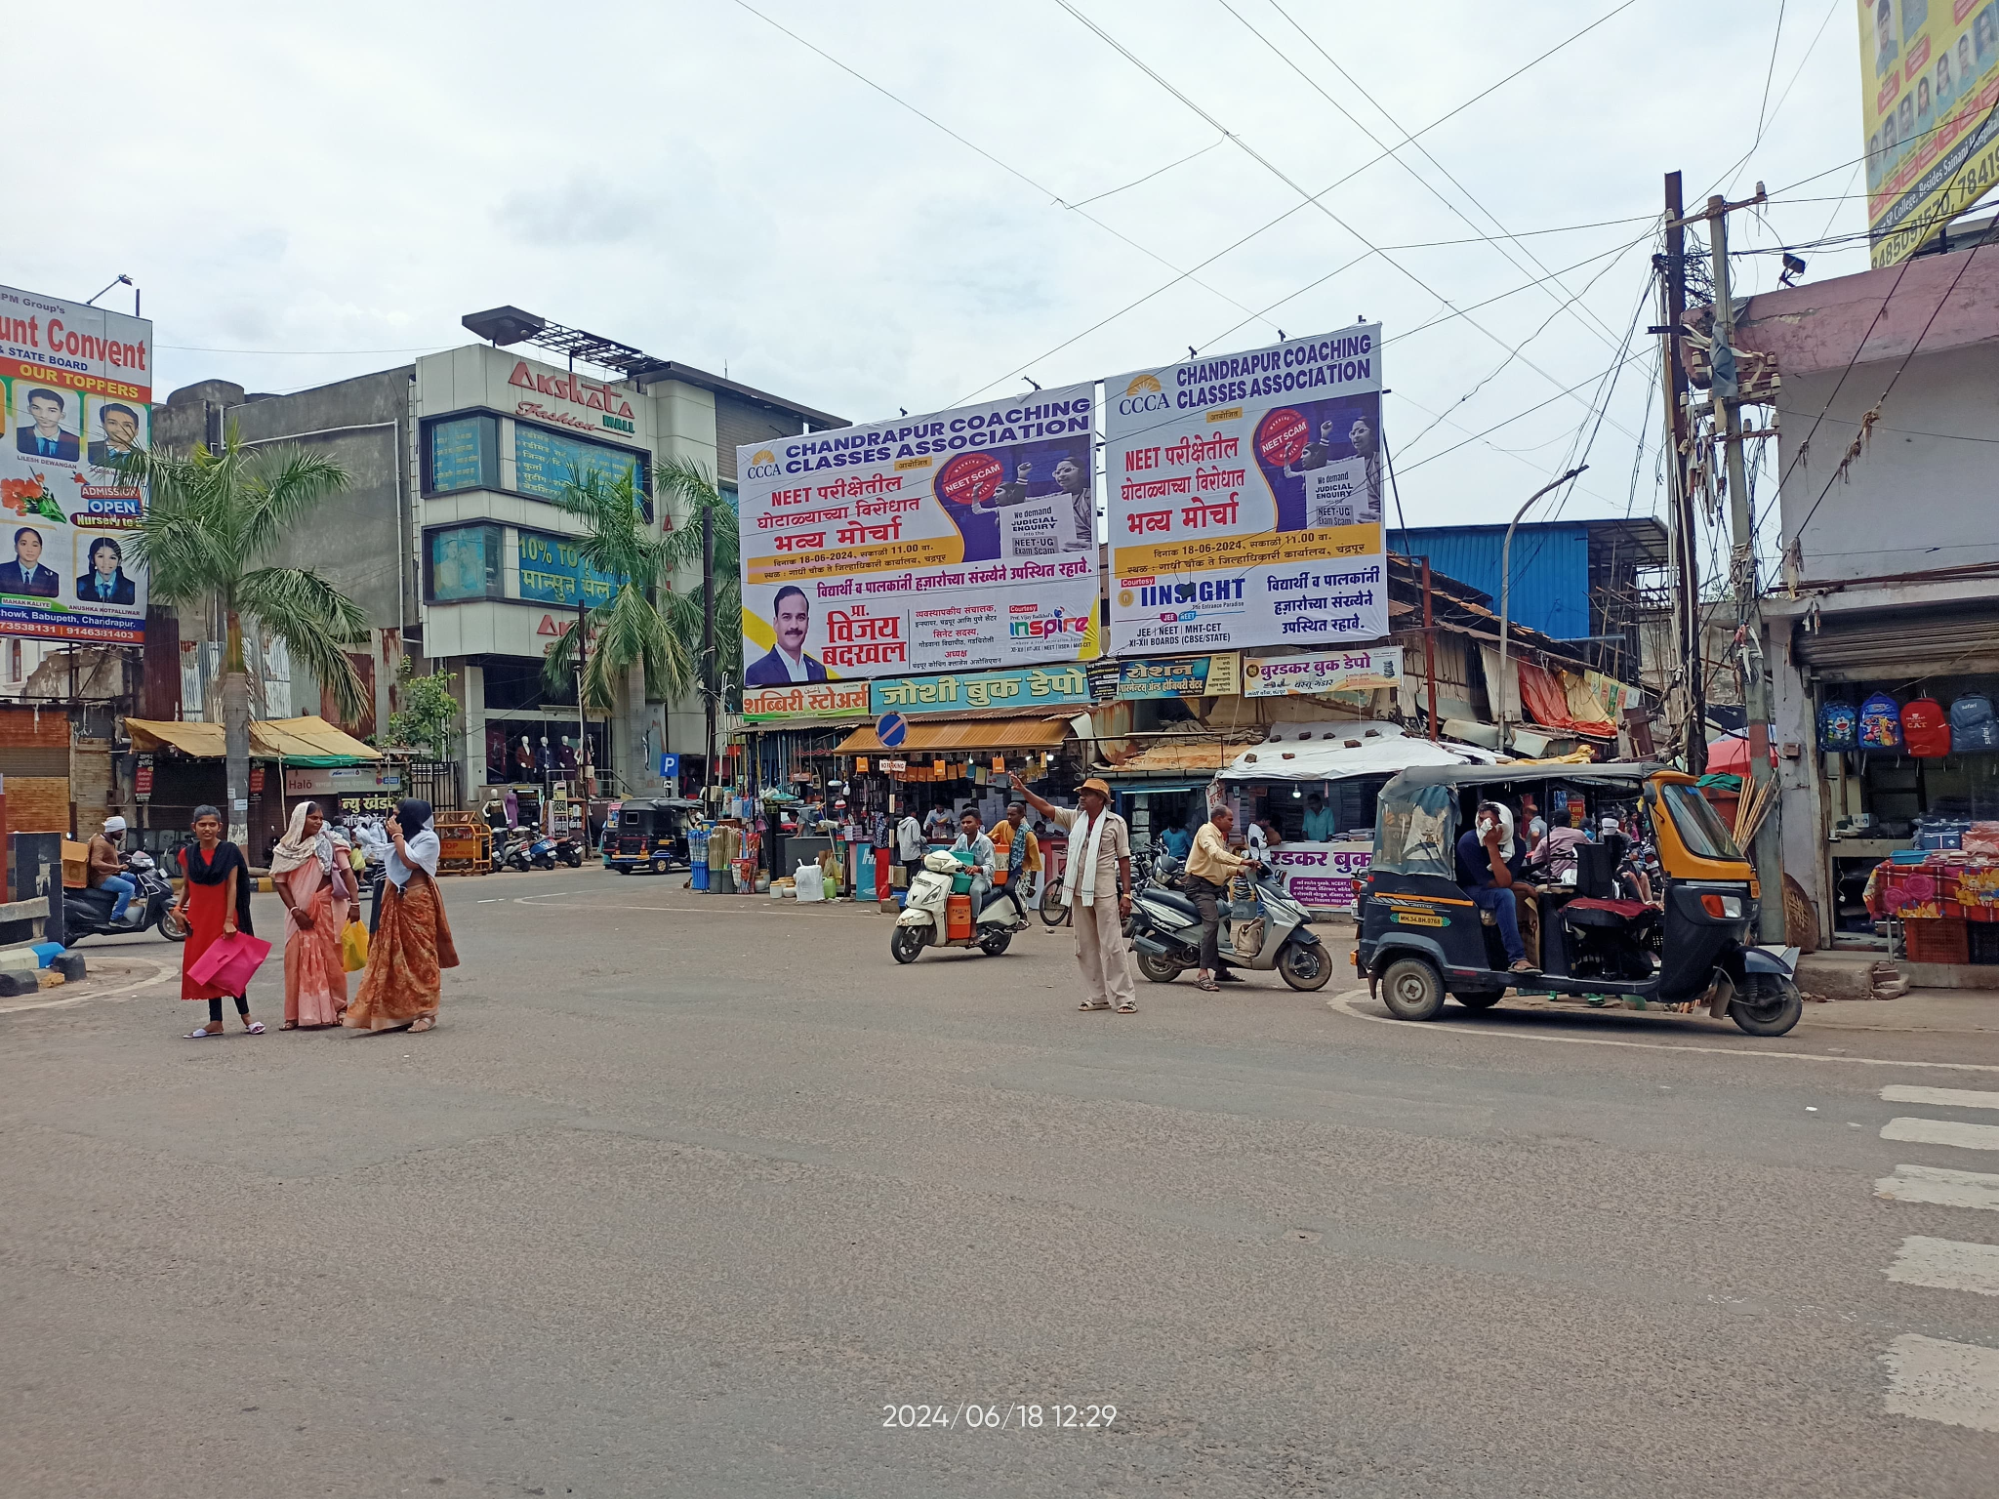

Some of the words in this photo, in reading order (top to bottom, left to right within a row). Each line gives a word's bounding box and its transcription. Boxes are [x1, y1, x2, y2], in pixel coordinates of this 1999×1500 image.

[1918, 169, 1943, 198] Besides
[22, 298, 66, 314] Group's
[47, 318, 146, 371] Convent
[8, 347, 46, 362] STATE
[49, 355, 88, 371] BOARD
[1177, 351, 1281, 387] CHANDRAPUR
[1283, 334, 1371, 368] COACHING
[19, 364, 58, 383] OUR
[63, 372, 139, 398] TOPPERS
[1177, 381, 1247, 410] CLASSES
[1250, 358, 1371, 398] ASSOCIATION
[1119, 392, 1171, 416] CCCA
[515, 401, 596, 431] Fashion
[602, 414, 636, 434] MALL
[786, 421, 945, 459] CHANDRAPUR
[949, 397, 1091, 433] COACHING
[785, 446, 891, 474] CLASSES
[895, 415, 1089, 459] ASSOCIATION
[1262, 435, 1283, 453] NEET
[1283, 421, 1307, 441] SCAM
[1125, 447, 1159, 471] NEET
[1164, 431, 1239, 466] परीक्षेतील
[40, 458, 77, 470] DEWANGAN
[747, 463, 781, 480] CCCA
[945, 476, 970, 493] NEET
[971, 464, 1001, 481] SCAM
[1121, 476, 1191, 501] घोटाळ्याच्या
[1195, 464, 1245, 492] विरोधात
[1315, 482, 1353, 493] JUDICIAL
[1326, 471, 1349, 483] demand
[771, 487, 812, 507] NEET
[817, 473, 903, 501] परीक्षेतील
[1316, 490, 1352, 500] ENQUIRY
[90, 501, 136, 514] OPEN
[757, 507, 849, 529] घोटाळ्याच्या
[855, 497, 921, 517] विरोधात
[1024, 506, 1052, 517] demand
[1127, 510, 1172, 535] भव्य
[1182, 492, 1239, 529] मोर्चा
[76, 514, 120, 527] Nursery
[1011, 516, 1058, 526] JUDICIAL
[1012, 523, 1056, 532] ENQUIRY
[774, 531, 826, 551] भव्य
[836, 515, 903, 545] मोर्चा
[519, 536, 553, 564] 10%
[557, 543, 578, 568] TO
[860, 547, 888, 557] सकाळी
[891, 544, 919, 554] 11.00
[1015, 547, 1033, 555] Exam
[1034, 546, 1055, 555] Scam
[1154, 547, 1179, 558] दिनांक
[1250, 537, 1282, 548] सकाळी
[835, 557, 882, 572] जिल्हाधिकारी
[1127, 565, 1149, 574] स्थळ
[1219, 550, 1280, 565] जिल्हाधिकारी
[817, 578, 853, 598] विद्यार्थी
[855, 582, 863, 594] व
[865, 572, 912, 593] पालकांनी
[968, 563, 1006, 584] संख्येने
[1010, 561, 1055, 581] उपस्थित
[1059, 556, 1092, 577] रहावे.
[1122, 577, 1154, 588] Courtesy
[1267, 572, 1310, 592] विद्यार्थी
[1312, 576, 1320, 588] व
[1324, 565, 1380, 587] पालकांनी
[68, 604, 98, 612] ANUSHKA
[1010, 605, 1037, 613] Courtesy
[1331, 589, 1373, 609] संख्येने
[31, 612, 80, 625] Babupeth,
[81, 616, 136, 629] Chandrapur.
[851, 604, 870, 617] प्रा.
[1163, 613, 1175, 621] JEE
[1180, 612, 1195, 620] NEET
[826, 610, 901, 643] विजय
[1010, 616, 1089, 640] inspire
[1137, 628, 1151, 637] JEE
[1159, 626, 1179, 636] NEET
[1185, 623, 1222, 634] MHT-CET
[1282, 617, 1327, 635] उपस्थित
[1332, 613, 1365, 633] रहावे.
[1151, 636, 1179, 646] BOARDS
[1181, 633, 1231, 646] (CBSE/STATE)
[821, 641, 907, 667] बदखल
[944, 649, 968, 659] अध्यक्ष
[1260, 662, 1311, 681] बुरडकर
[1313, 659, 1341, 677] बुक
[1343, 652, 1371, 670] डेपो
[808, 683, 869, 710] स्टोअर्स
[879, 675, 959, 706] जोशी
[963, 676, 1022, 707] बुक
[1026, 667, 1087, 697] डेपो
[1961, 702, 1977, 710] safari
[1981, 727, 1991, 745] safari
[664, 757, 675, 772] P
